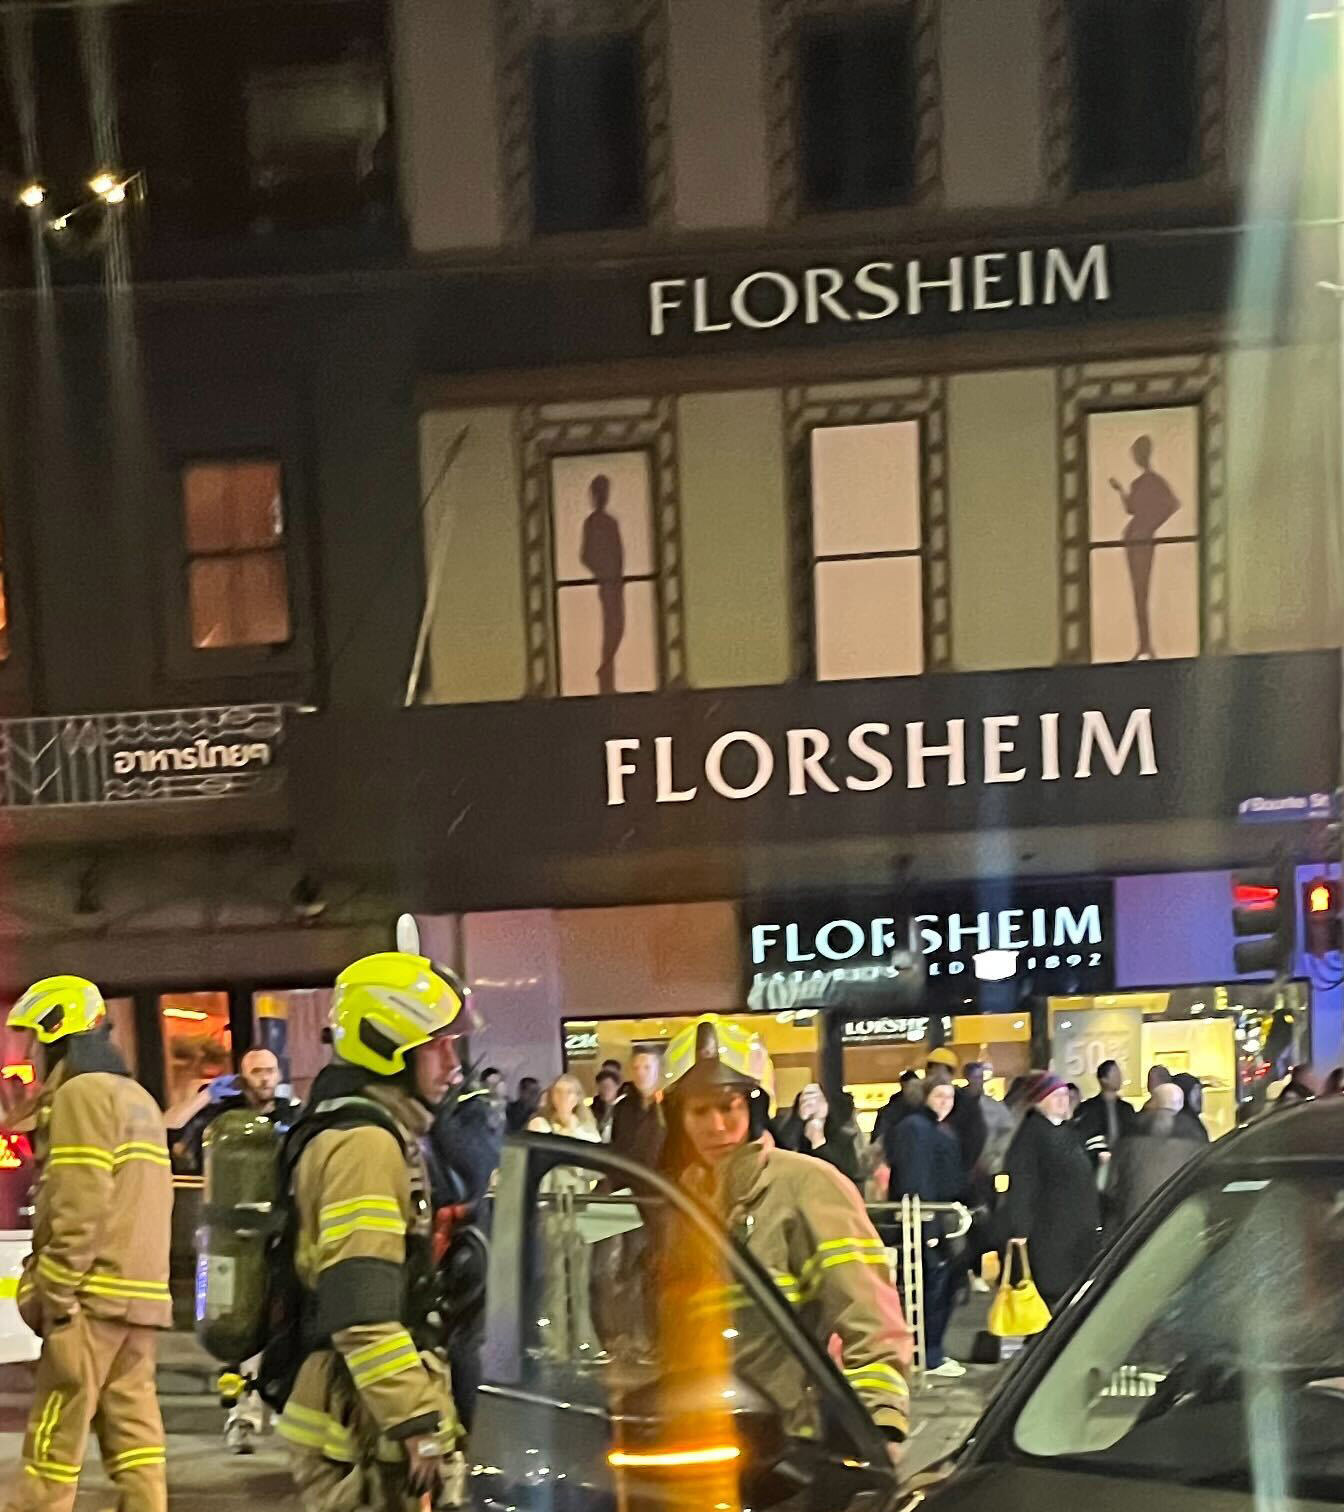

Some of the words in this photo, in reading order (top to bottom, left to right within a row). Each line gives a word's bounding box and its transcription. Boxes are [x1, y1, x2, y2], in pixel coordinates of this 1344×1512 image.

[649, 243, 1109, 336] FLORSHEIM
[604, 707, 1159, 806] FLORSHEIM
[1027, 952, 1103, 970] 1892
